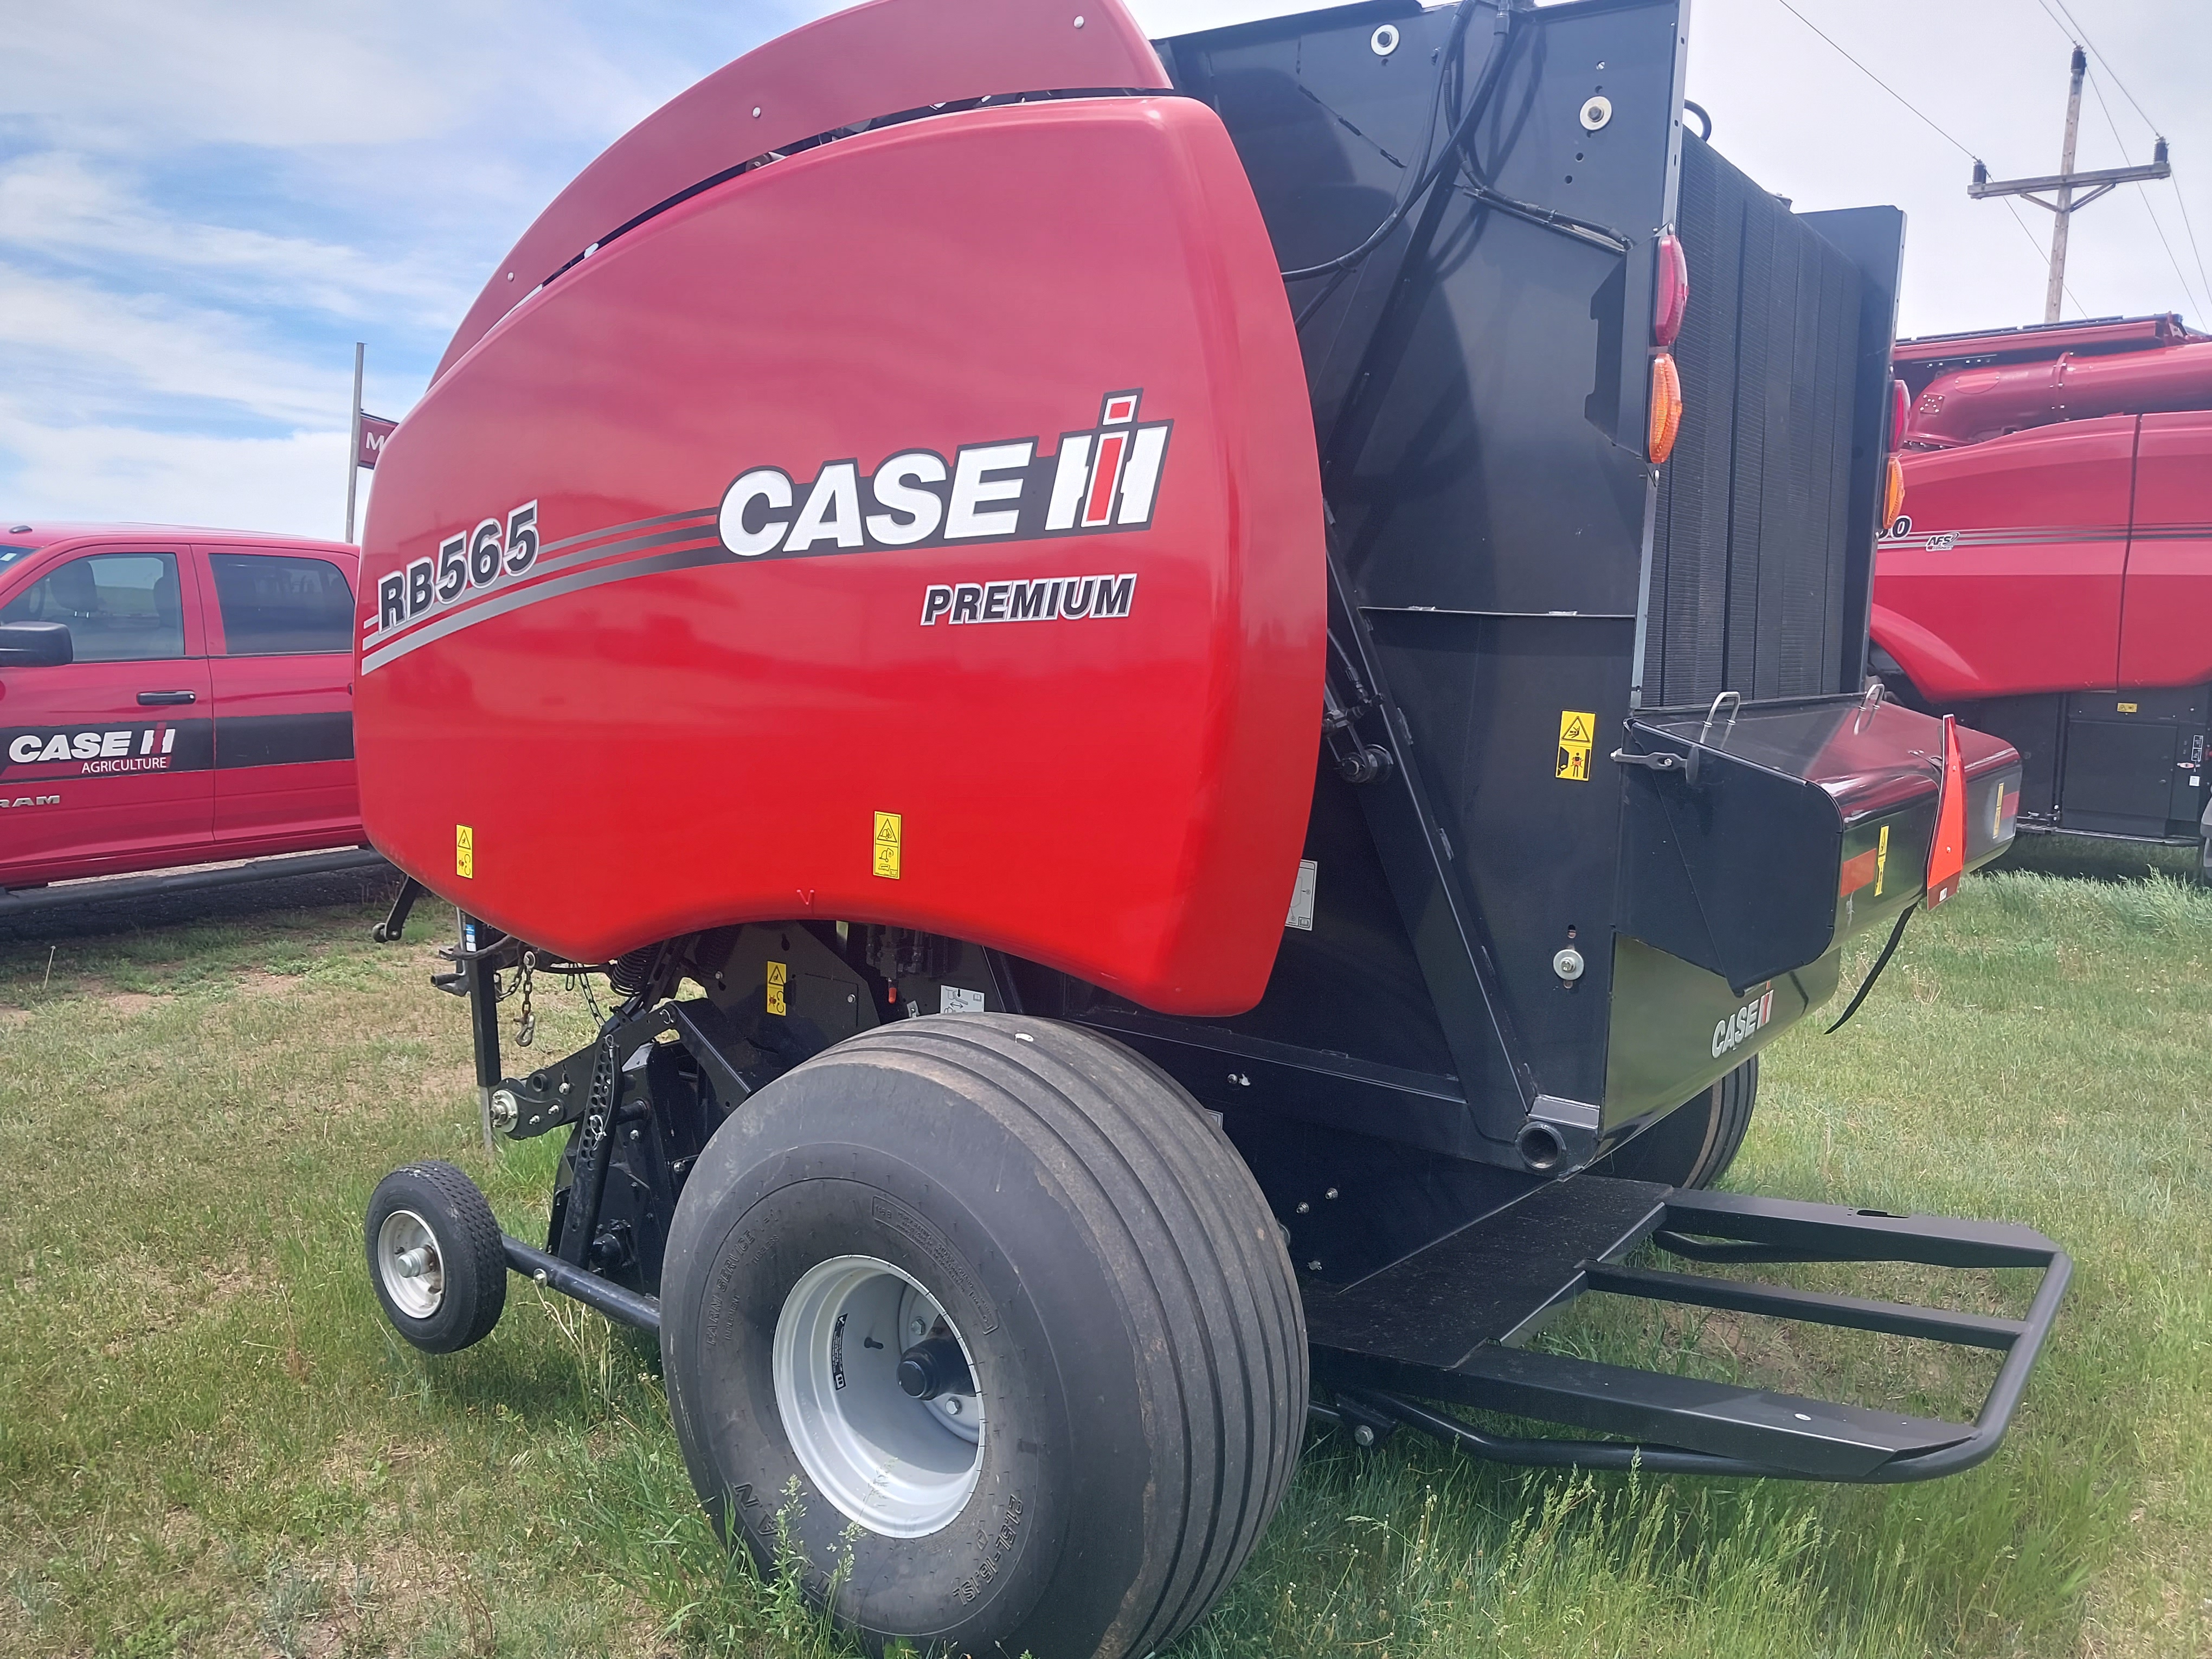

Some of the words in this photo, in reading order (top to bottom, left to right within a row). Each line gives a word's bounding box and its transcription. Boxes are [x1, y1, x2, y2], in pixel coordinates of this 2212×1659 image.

[719, 442, 1033, 556] CASE
[1045, 395, 1169, 531] IH
[378, 499, 539, 634] RB565
[1926, 535, 1952, 546] AFS
[921, 574, 1137, 626] PREMIUM
[9, 731, 132, 763] CASE
[81, 757, 167, 774] AGRICULTURE
[1712, 999, 1759, 1059] CASE
[751, 1234, 780, 1265] TUBELESS
[706, 1294, 723, 1346] FARM
[716, 1229, 755, 1293] SERVICE
